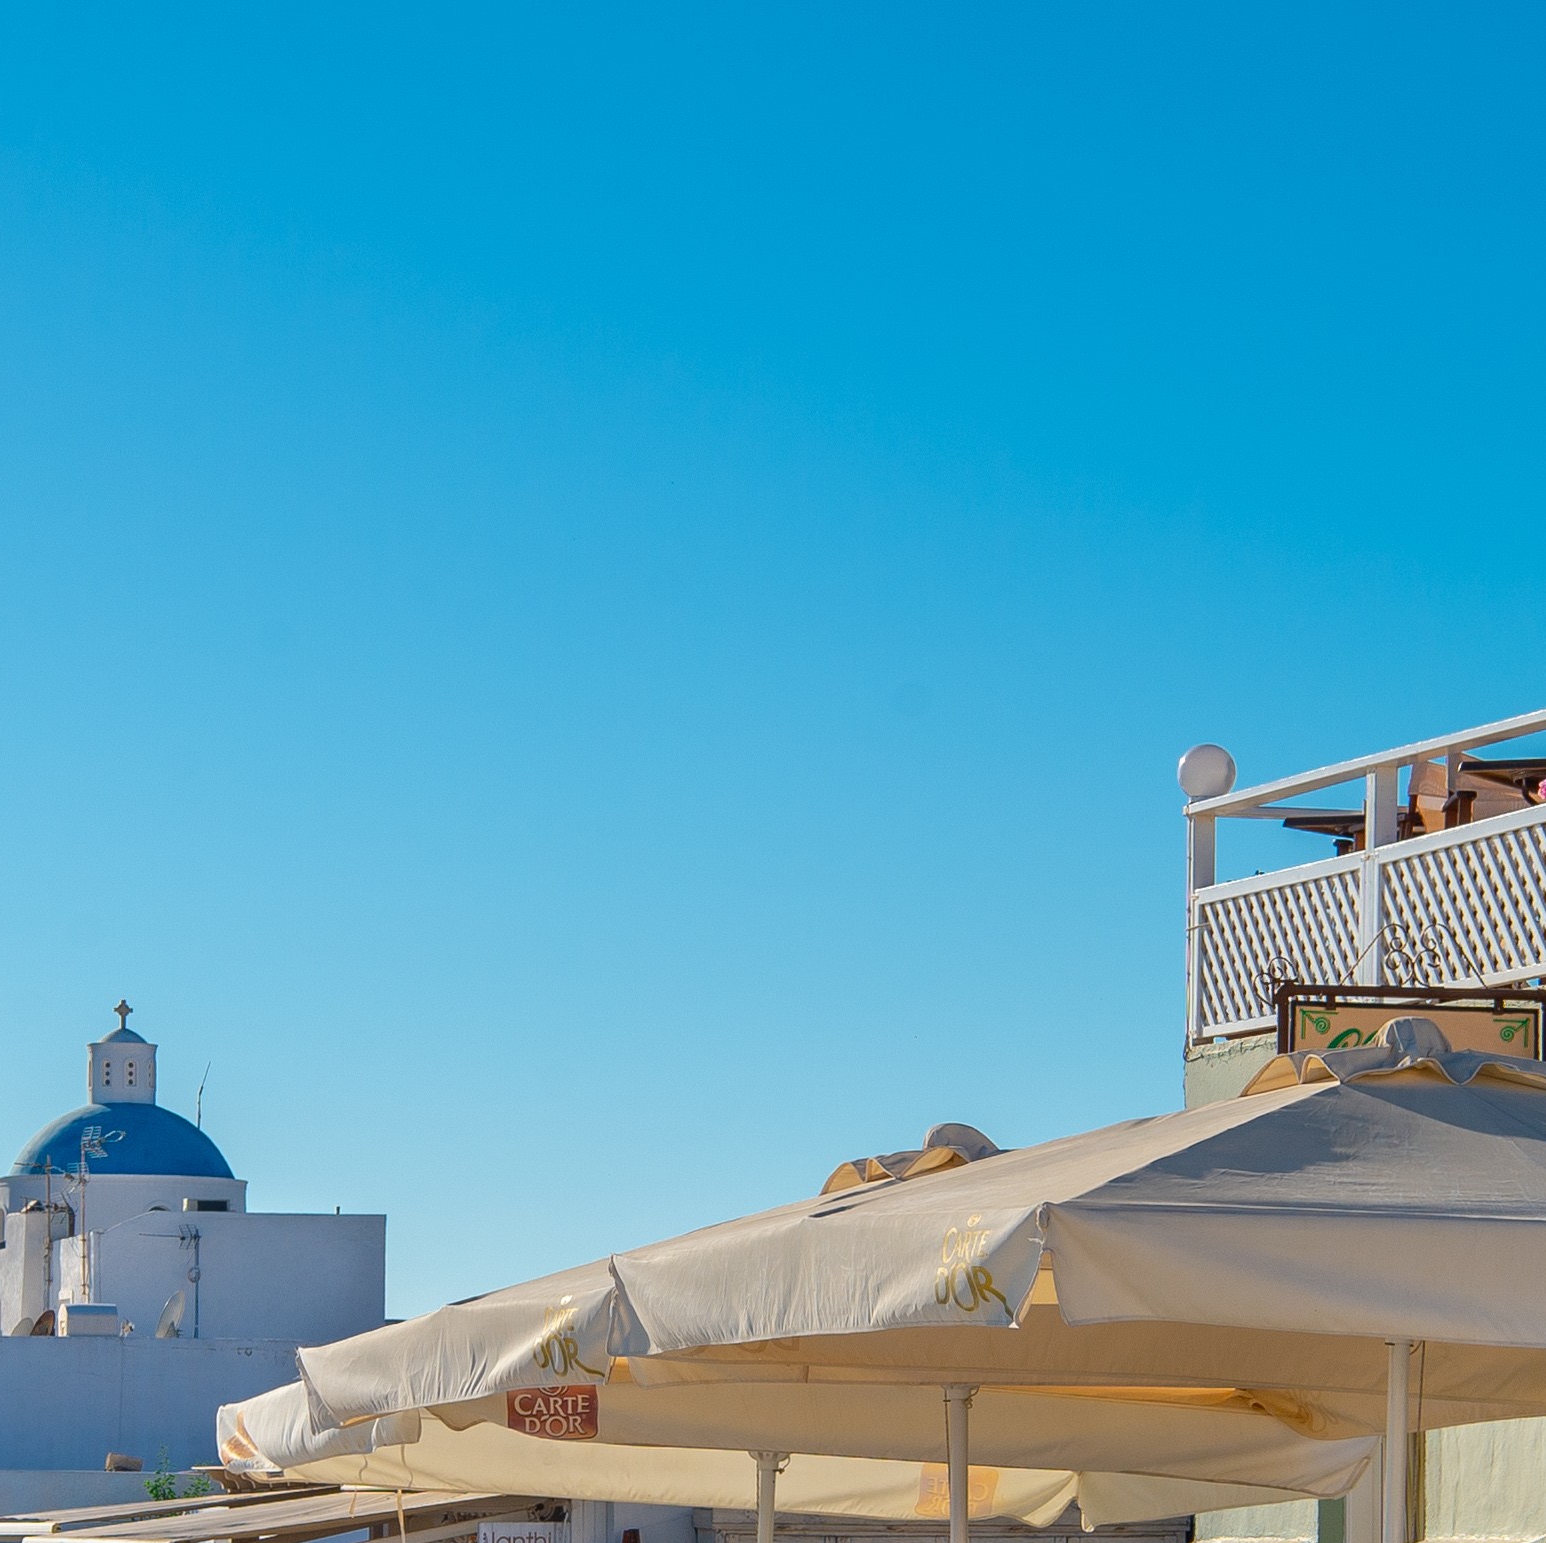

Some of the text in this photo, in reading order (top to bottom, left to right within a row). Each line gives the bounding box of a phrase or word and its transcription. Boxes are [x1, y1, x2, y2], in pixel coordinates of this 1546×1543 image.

[942, 1227, 992, 1264] CARTE
[514, 1393, 590, 1417] CARTE
[524, 1415, 587, 1437] D'OR
